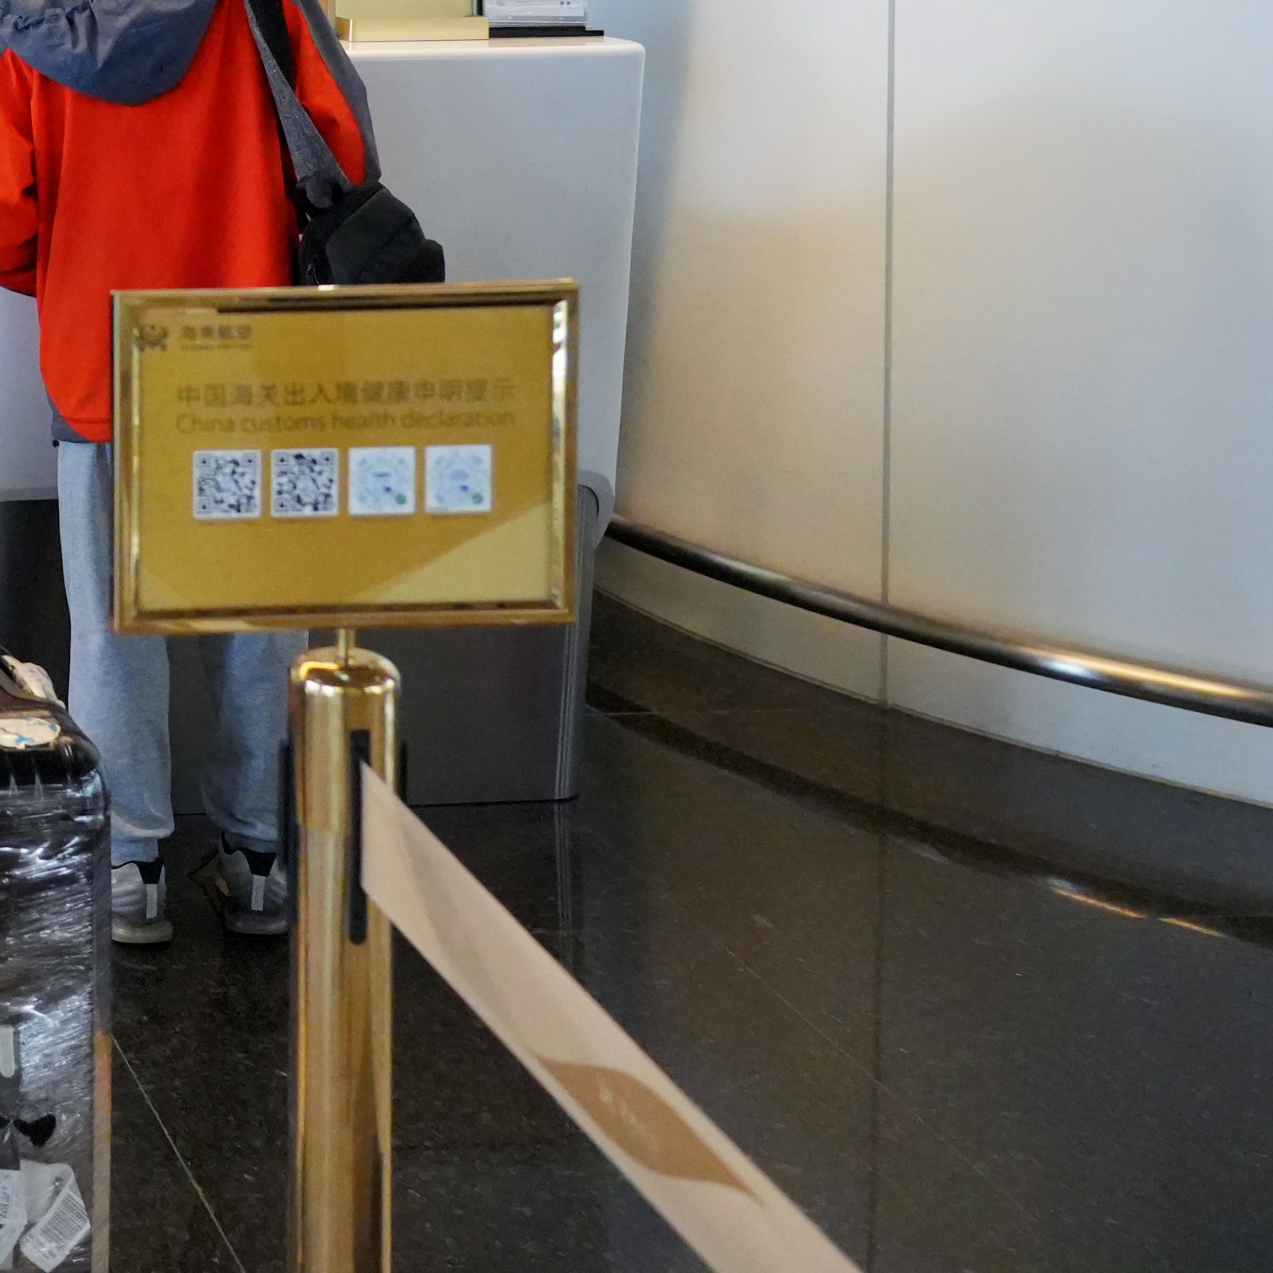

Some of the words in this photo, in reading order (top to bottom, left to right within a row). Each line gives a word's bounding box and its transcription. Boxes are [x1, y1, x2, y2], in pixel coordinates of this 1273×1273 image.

[176, 413, 236, 434] China
[241, 413, 326, 433] customs
[331, 410, 396, 430] health
